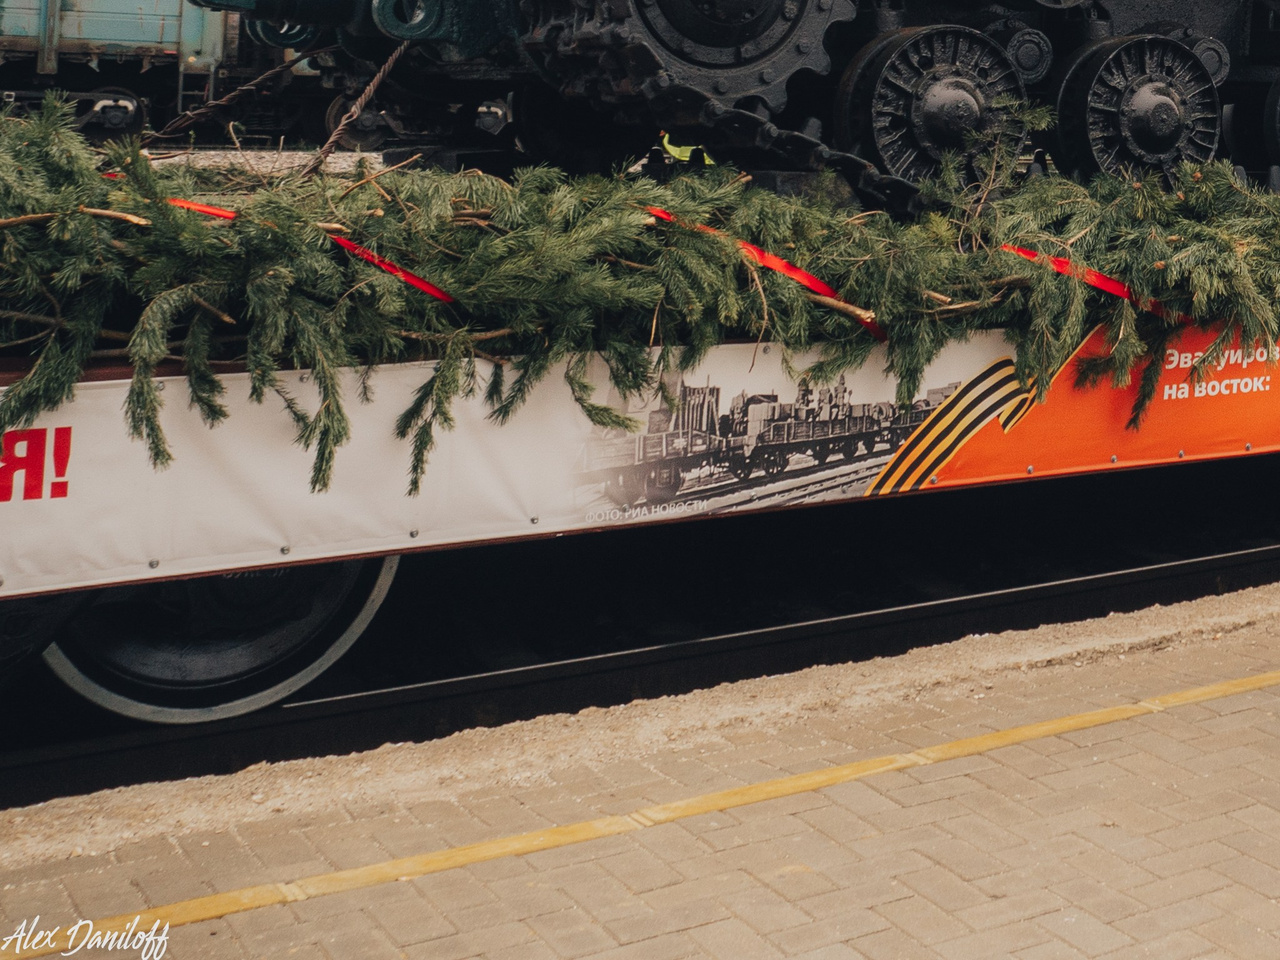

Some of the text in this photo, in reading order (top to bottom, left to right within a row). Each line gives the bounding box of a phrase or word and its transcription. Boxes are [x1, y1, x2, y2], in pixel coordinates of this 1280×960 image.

[1163, 375, 1271, 401] на восток:
[624, 506, 649, 519] РИА
[651, 499, 708, 516] НОВОСТИ
